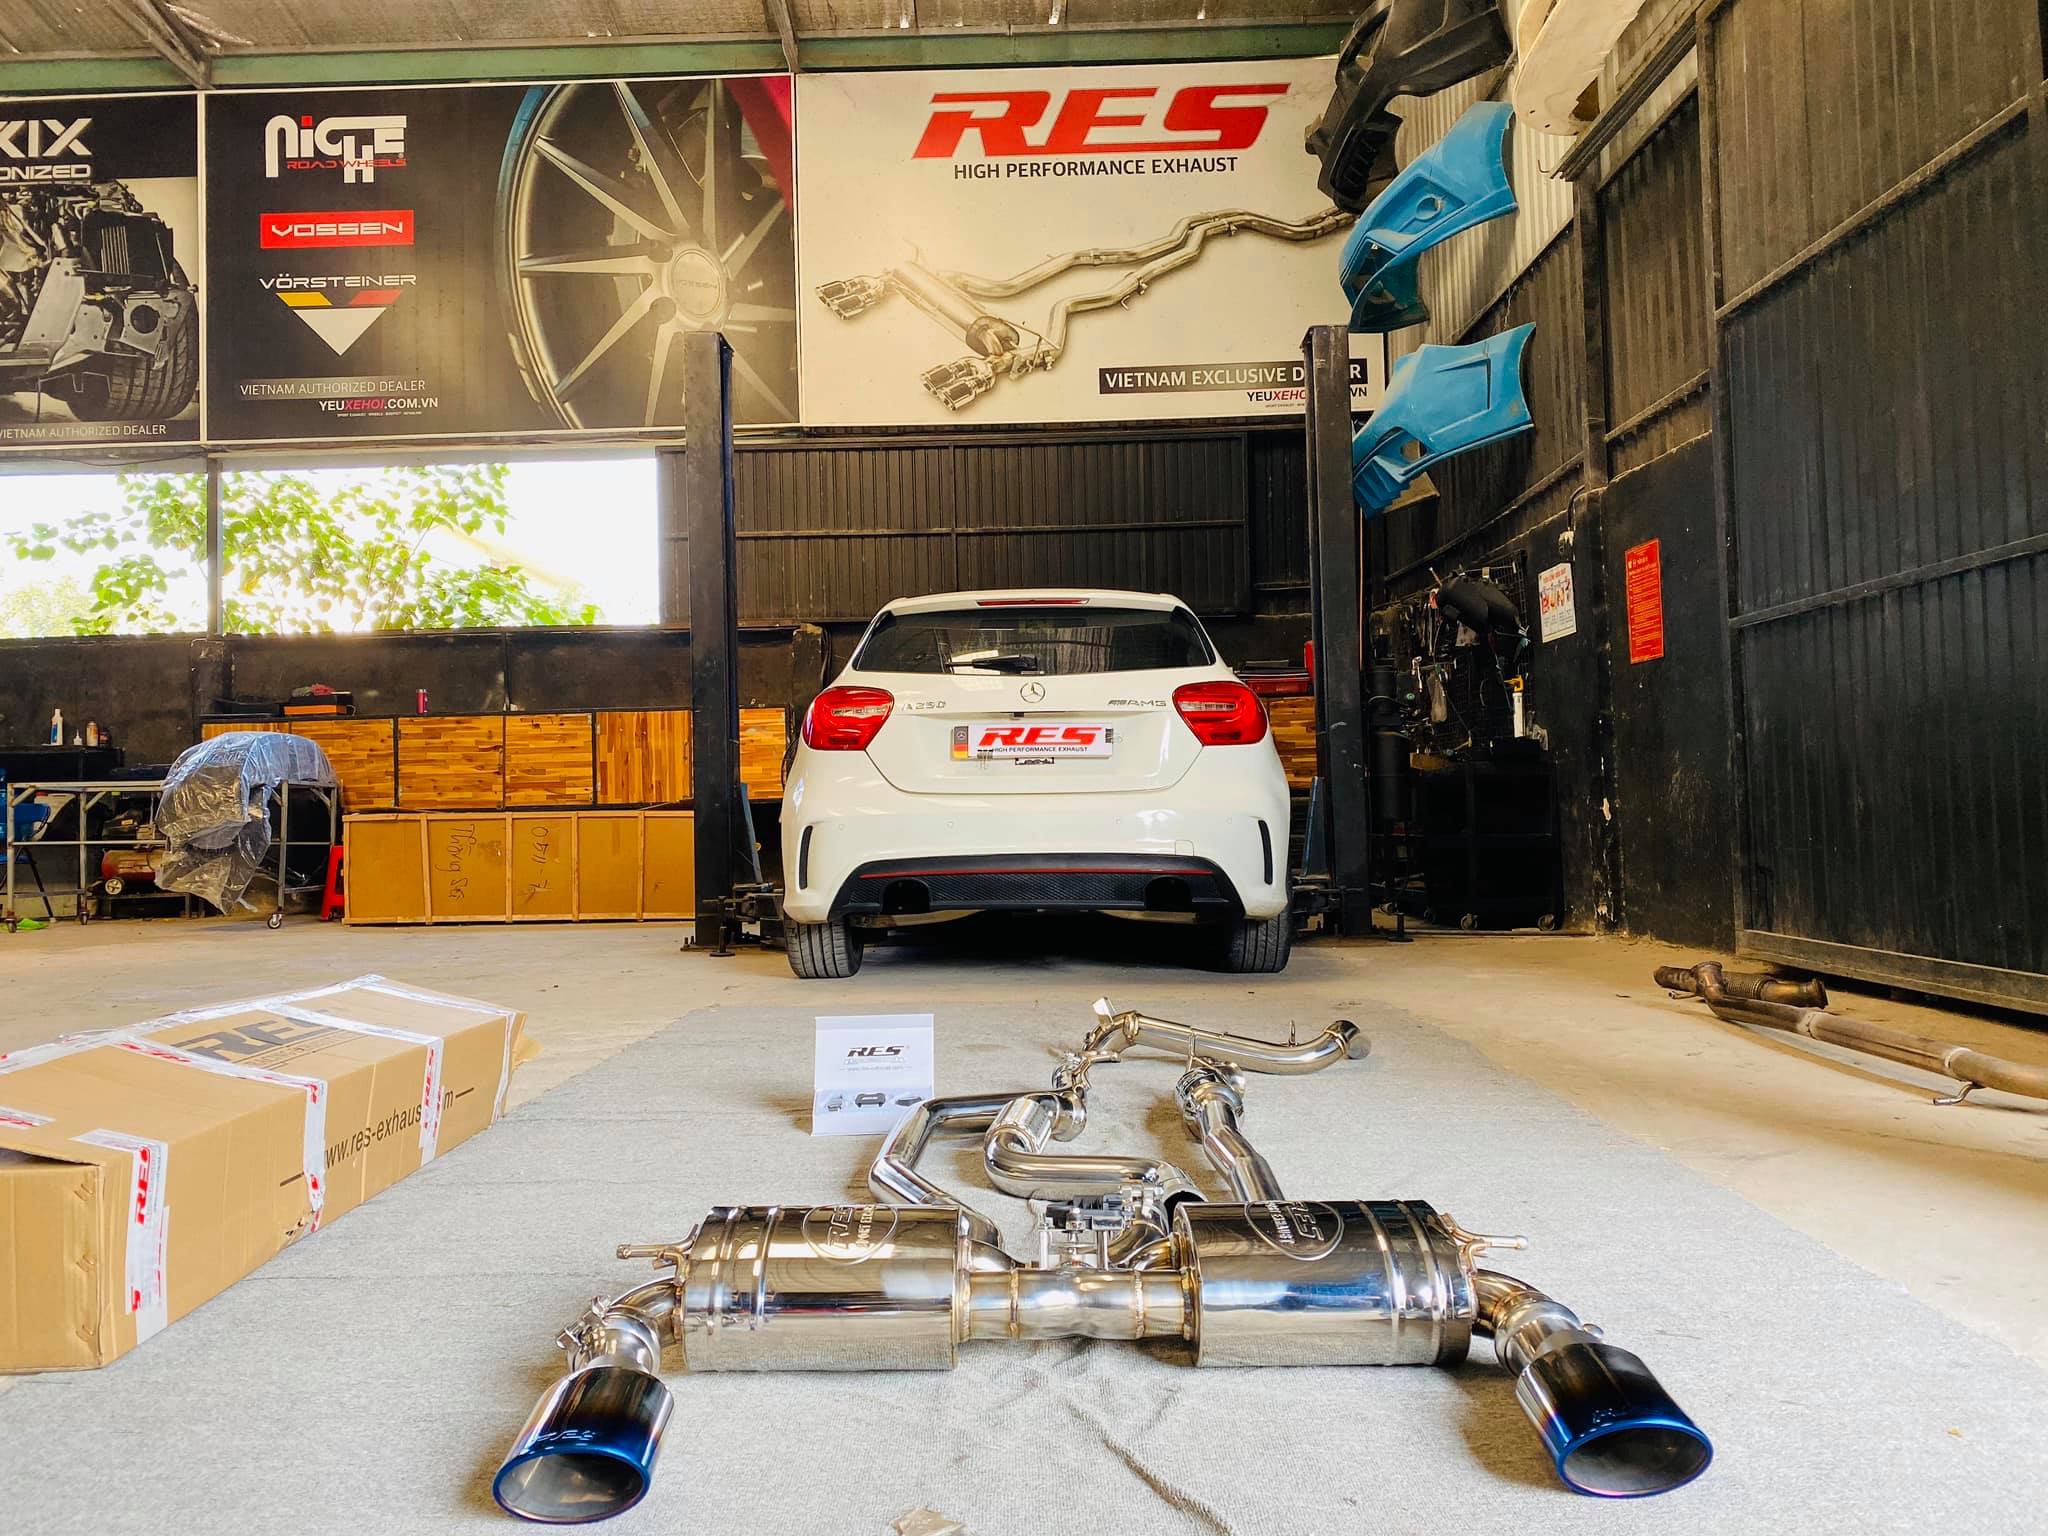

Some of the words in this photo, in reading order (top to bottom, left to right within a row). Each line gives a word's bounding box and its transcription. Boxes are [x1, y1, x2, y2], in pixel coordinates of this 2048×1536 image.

[912, 83, 1291, 160] RES
[953, 162, 1000, 180] HIGH
[1006, 158, 1145, 178] PERFORMANCE
[1151, 156, 1238, 174] EXHAUST
[271, 222, 404, 237] VOSSEN
[259, 273, 417, 289] VÖRSTEINER
[1105, 371, 1186, 389] VIETNAM
[1191, 366, 1288, 386] EXCLUSIVE
[240, 383, 295, 396] VIETNAM
[298, 380, 376, 394] AUTHORIZED
[379, 379, 426, 392] DEALER
[319, 397, 439, 411] YEUXEHOI.COM.VN
[50, 425, 120, 438] AUTHORIZED
[123, 424, 167, 436] DEALER
[978, 726, 1102, 746] RES
[847, 1045, 905, 1058] RES
